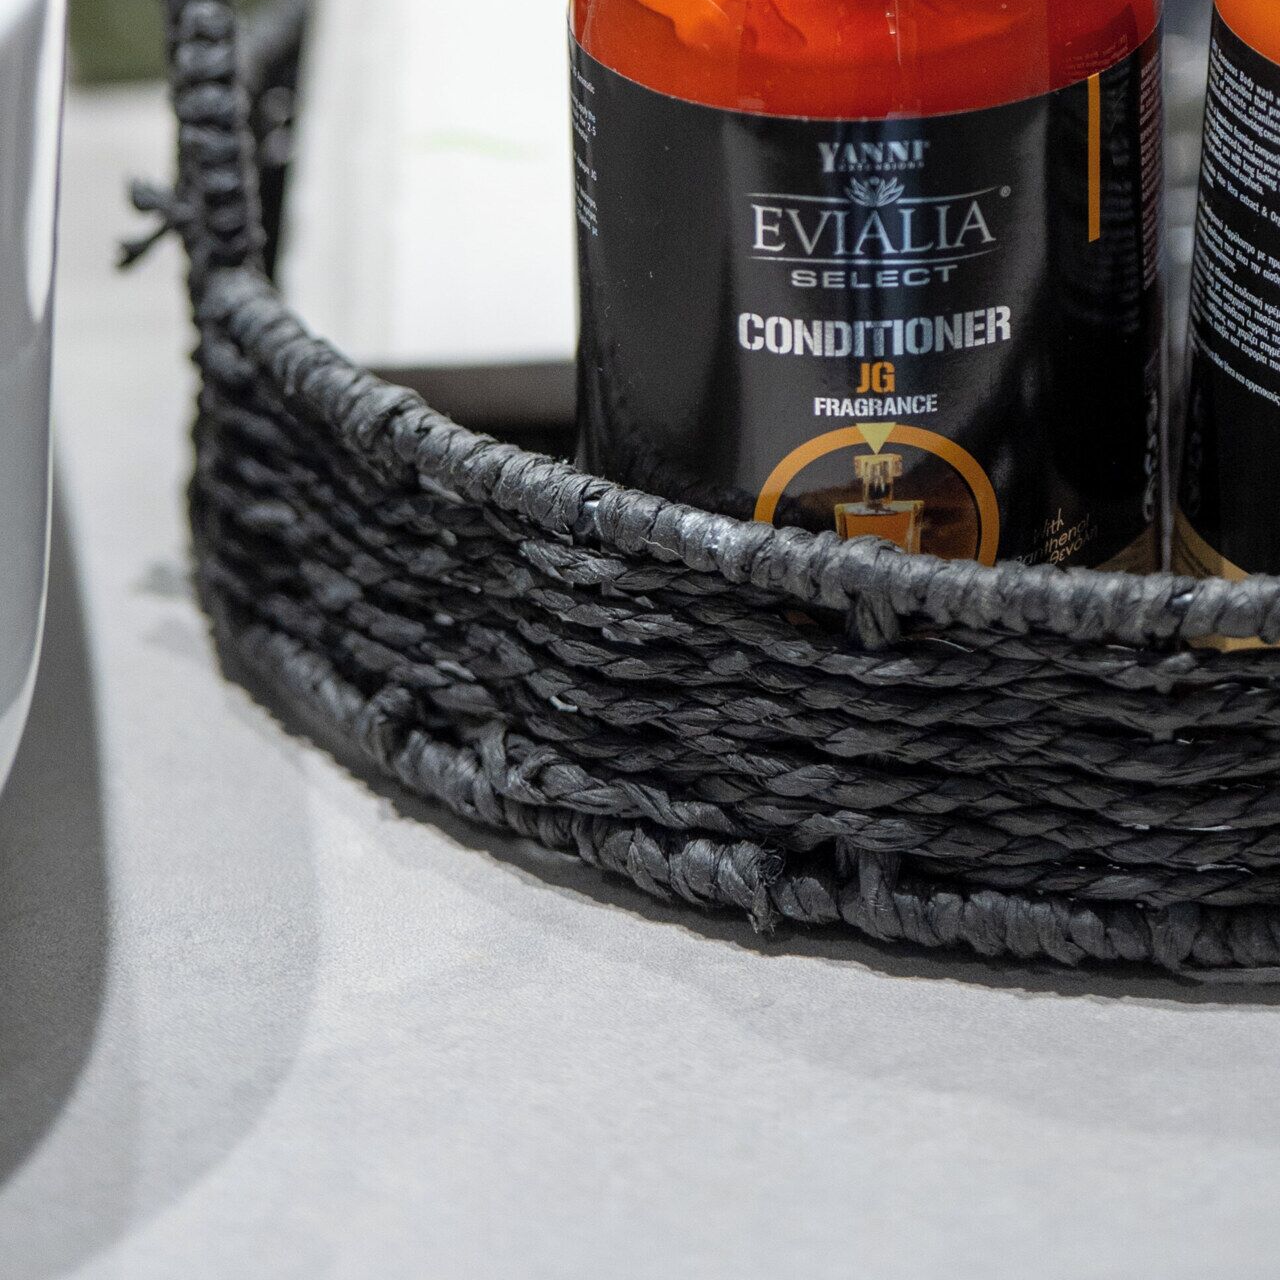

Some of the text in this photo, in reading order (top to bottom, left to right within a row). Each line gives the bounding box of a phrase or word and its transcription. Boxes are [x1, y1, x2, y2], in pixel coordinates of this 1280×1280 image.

[1239, 71, 1254, 90] Body
[1255, 85, 1273, 101] wash
[1253, 95, 1266, 111] that
[817, 139, 928, 173] YANNI
[1256, 169, 1277, 191] lasting
[1239, 194, 1259, 213] extract
[1261, 206, 1268, 218] &
[750, 200, 998, 254] EVIALIA
[790, 264, 959, 290] SELECT
[737, 304, 1013, 359] CONDITIONER
[856, 362, 896, 394] JG
[813, 394, 939, 417] FRAGRANCE
